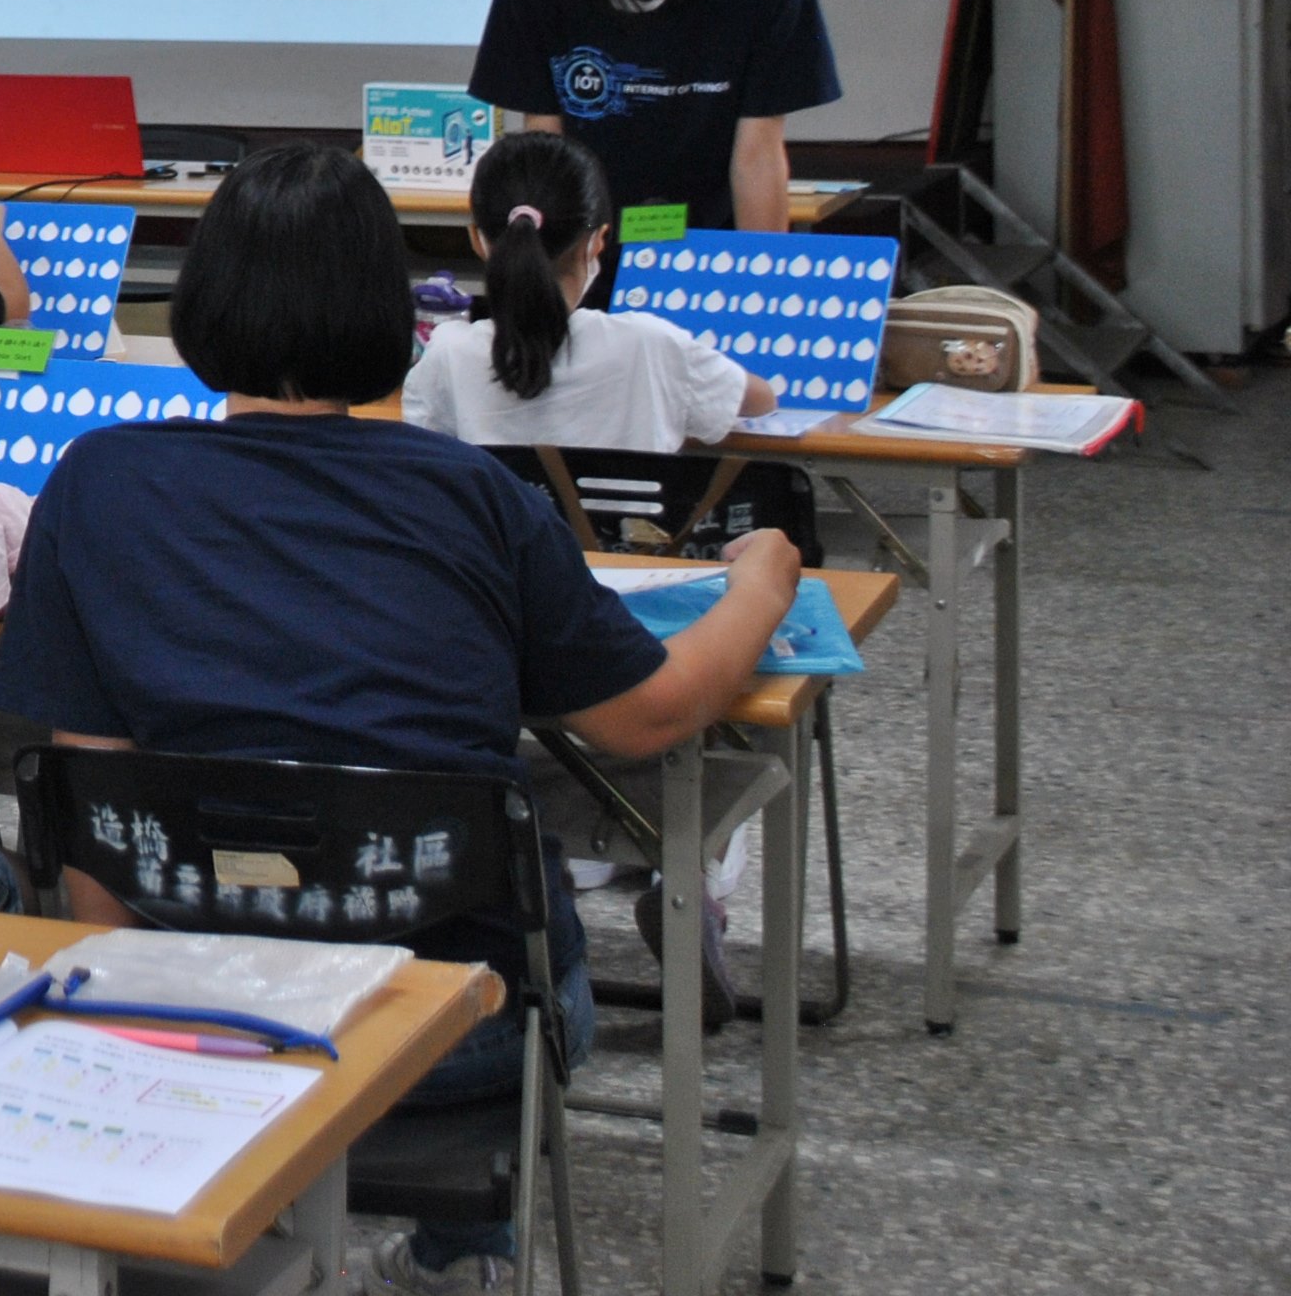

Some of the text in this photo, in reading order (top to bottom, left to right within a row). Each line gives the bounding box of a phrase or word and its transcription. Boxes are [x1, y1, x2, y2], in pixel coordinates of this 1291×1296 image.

[575, 75, 601, 90] IOT
[623, 84, 676, 96] INTERNET
[691, 81, 730, 93] THINGS
[355, 831, 451, 880] 社區
